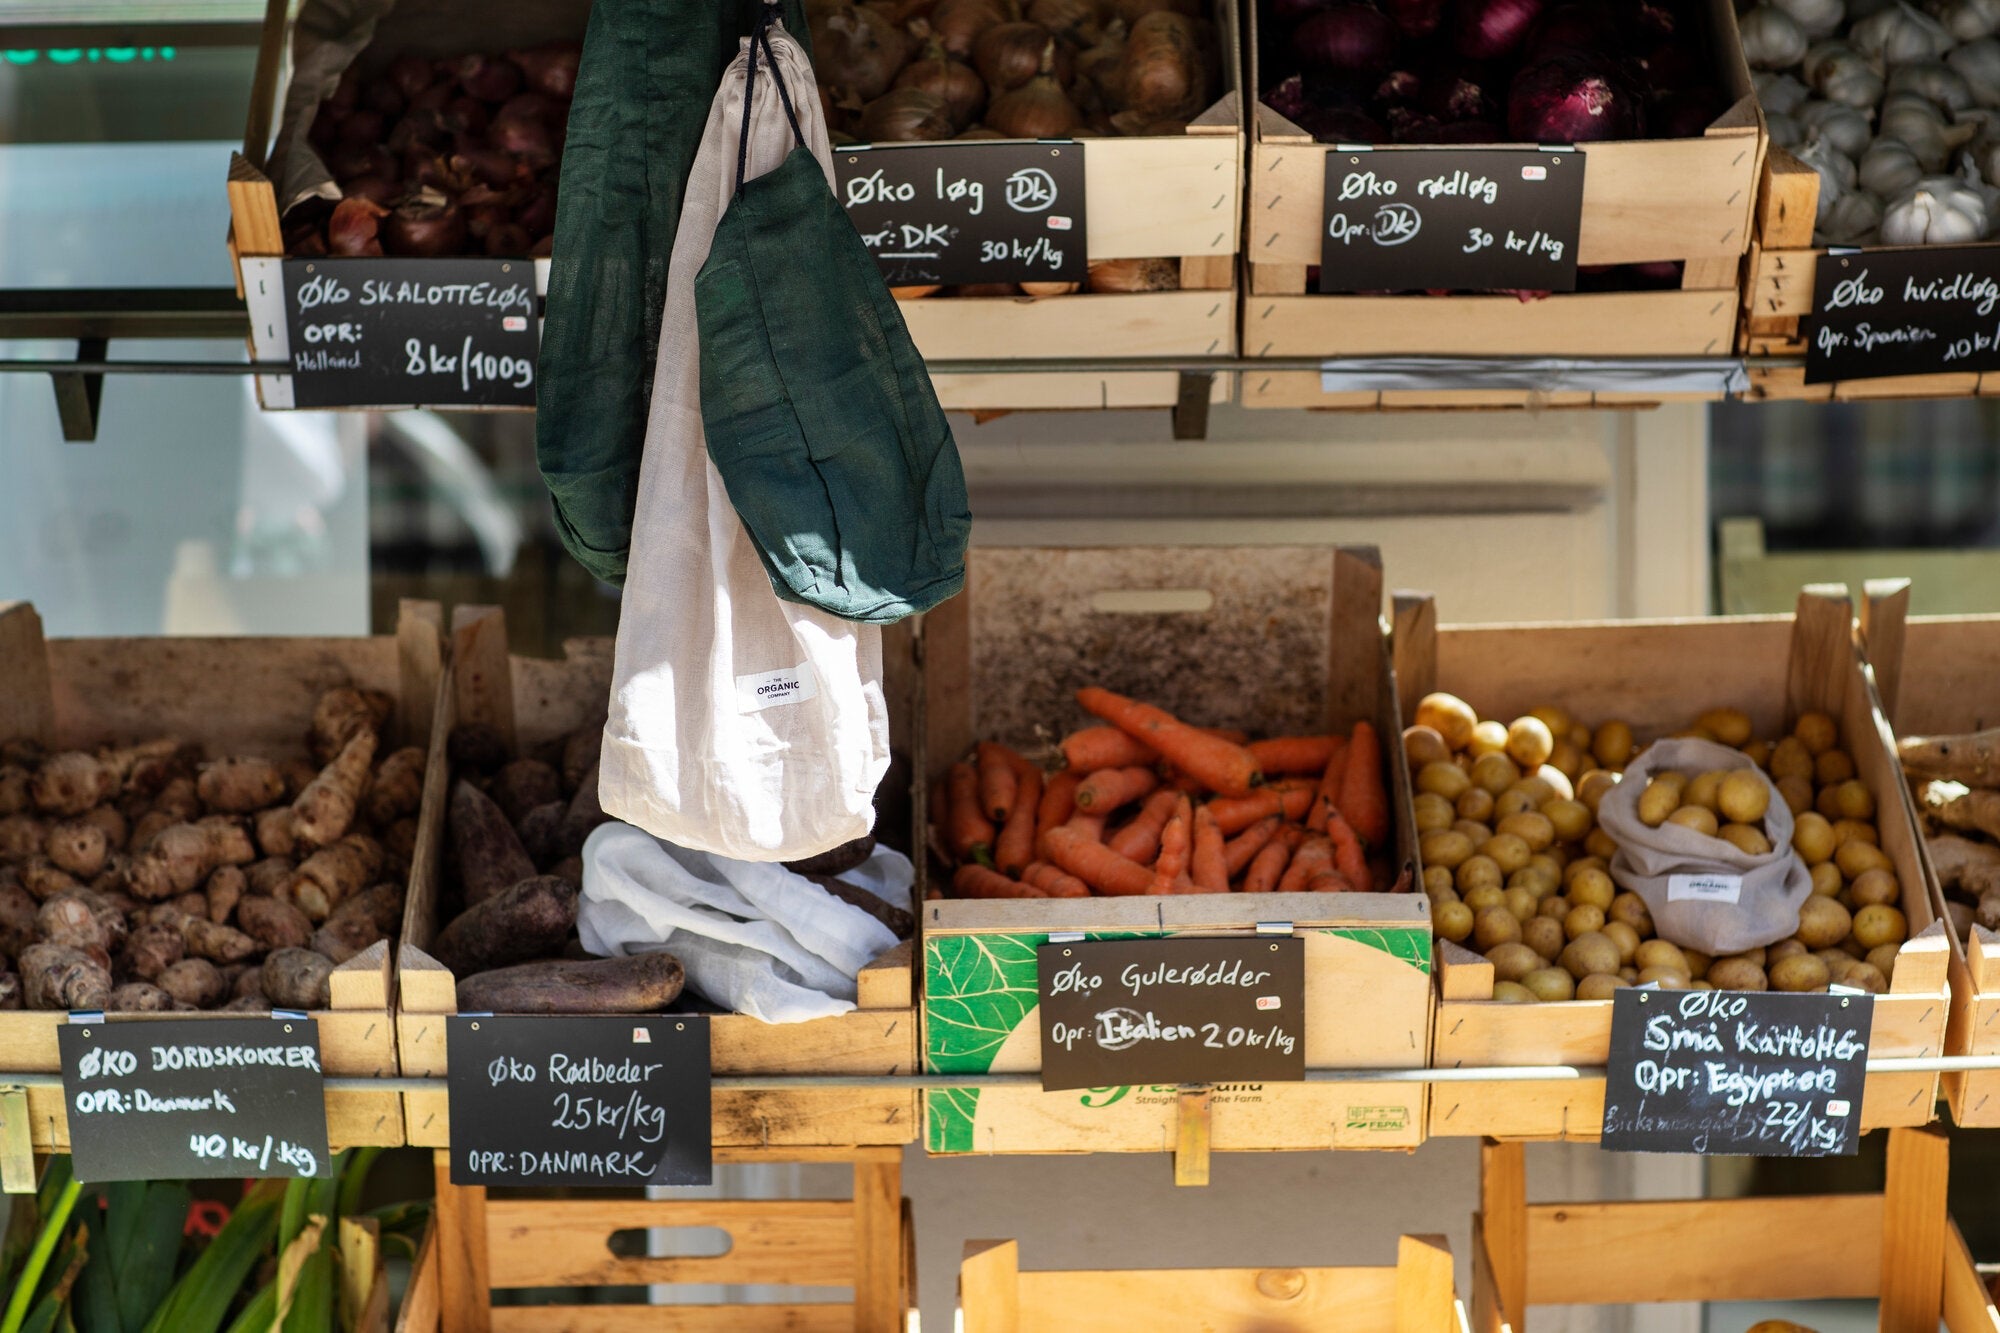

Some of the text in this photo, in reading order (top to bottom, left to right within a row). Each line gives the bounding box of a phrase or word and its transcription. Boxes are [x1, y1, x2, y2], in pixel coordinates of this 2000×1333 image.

[846, 169, 915, 208] Øko
[936, 167, 984, 215] løg
[1338, 169, 1498, 204] Øko rødløg
[1329, 213, 1370, 245] Opr:
[1462, 227, 1565, 261] 30 kr/kg
[1823, 268, 2000, 316] Øko hvidløg
[304, 323, 363, 344] OPR:
[1817, 322, 1937, 358] Opr: Spanien
[295, 351, 362, 372] Holland
[757, 681, 800, 695] ORGANIC
[1050, 959, 1270, 997] Øko Gulerødder
[1679, 989, 1747, 1021] Øko
[1052, 1022, 1092, 1051] Opr:
[1095, 1011, 1196, 1045] Italien
[1643, 1014, 1723, 1052] Små
[78, 1047, 137, 1080] ØKO
[488, 1053, 663, 1087] Øko Rødbeder
[1635, 1059, 1700, 1096] Opr:
[1135, 1095, 1178, 1106] Straigh
[1233, 1094, 1262, 1103] Farm
[189, 1133, 228, 1158] 40
[469, 1150, 657, 1178] OPR: DANMARK
